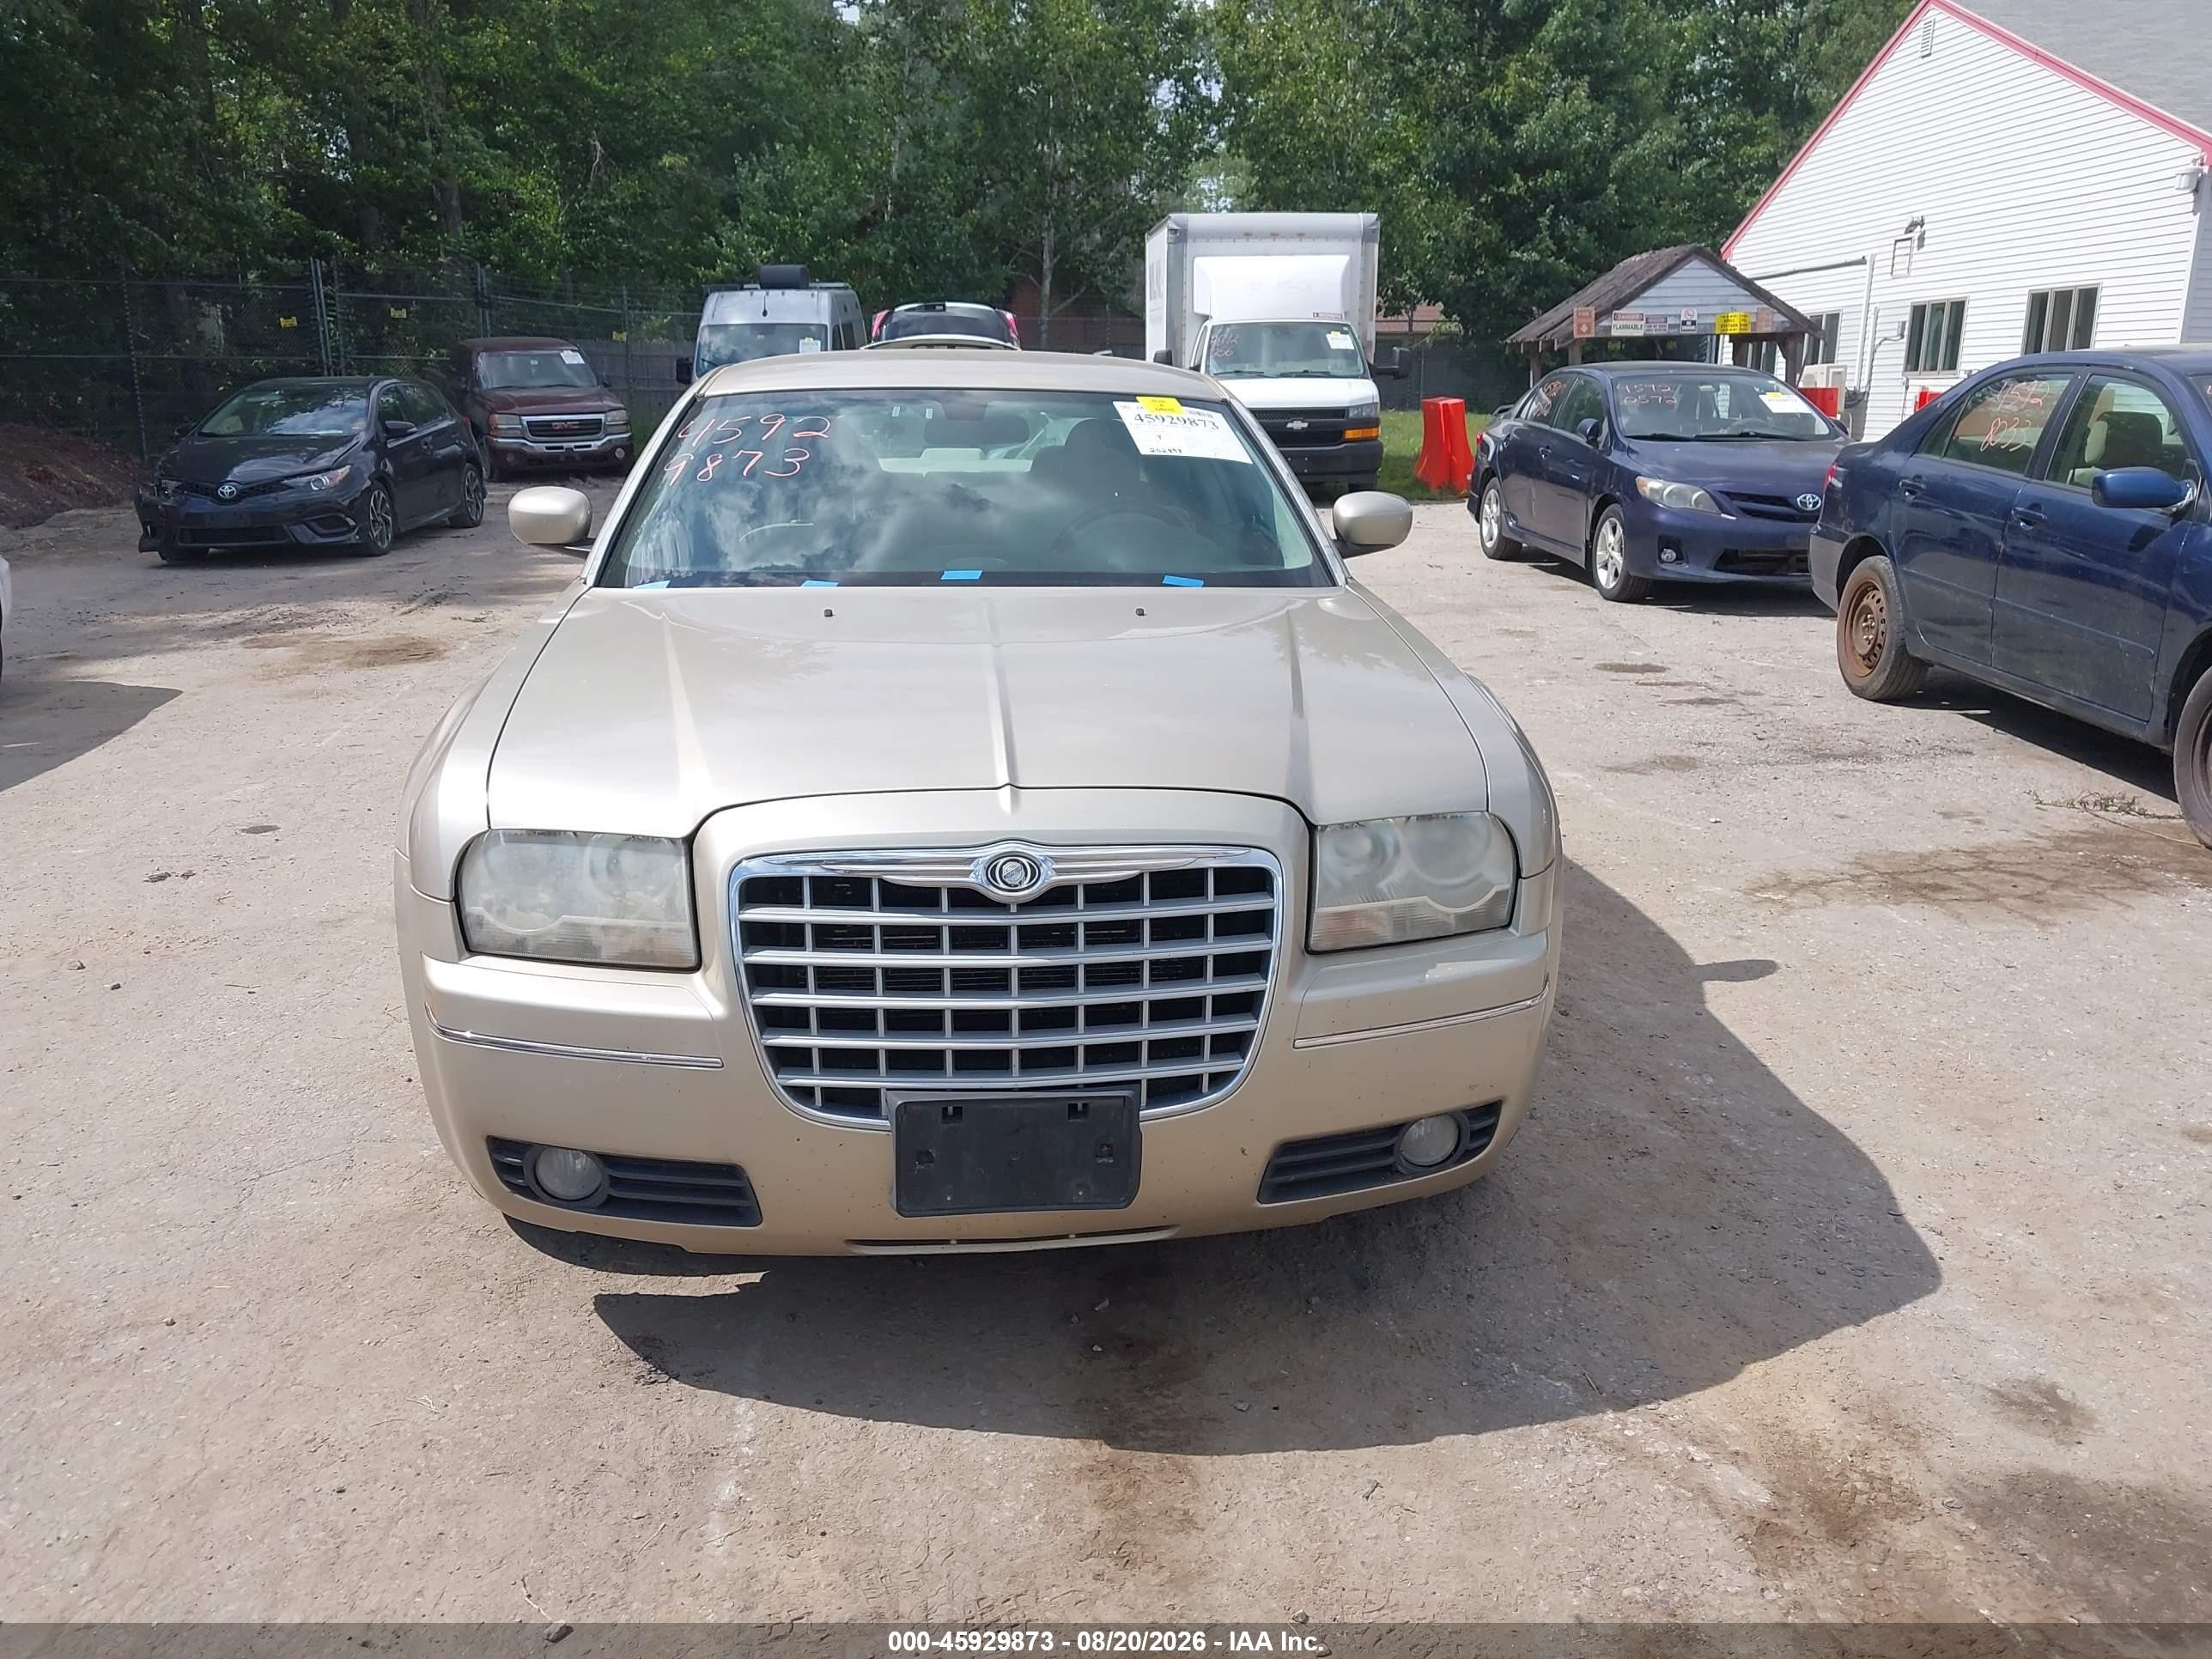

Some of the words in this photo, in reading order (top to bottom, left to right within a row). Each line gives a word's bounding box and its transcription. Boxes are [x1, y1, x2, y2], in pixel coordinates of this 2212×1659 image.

[1996, 380, 2050, 410] 4592
[678, 413, 831, 447] 4592
[1134, 413, 1219, 430] 45929873
[664, 447, 811, 486] 9873
